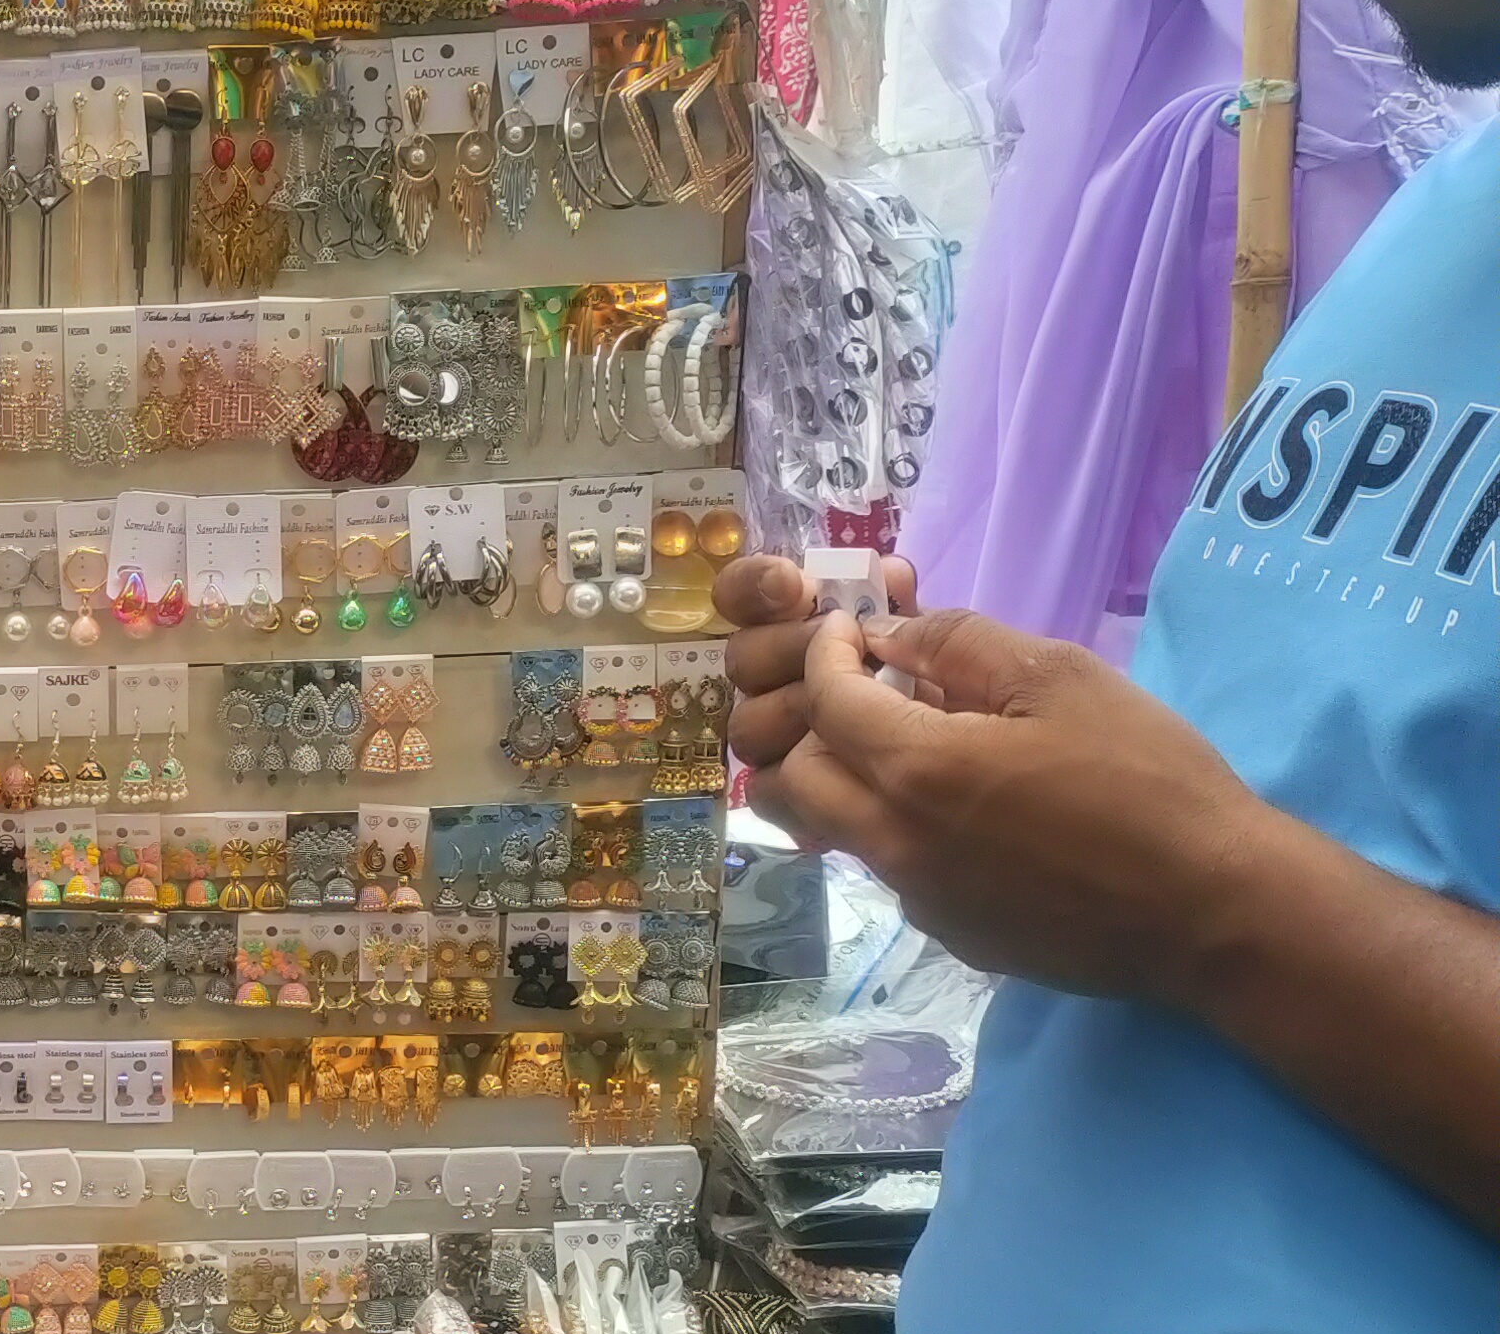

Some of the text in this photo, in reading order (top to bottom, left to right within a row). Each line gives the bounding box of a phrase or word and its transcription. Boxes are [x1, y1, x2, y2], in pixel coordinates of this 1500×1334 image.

[505, 38, 528, 55] LC
[401, 47, 425, 63] LC
[517, 55, 583, 72] LADY CARE
[414, 65, 481, 79] LADY CARE
[569, 482, 643, 499] Fashion Jewelry
[445, 502, 473, 516] S.W
[661, 495, 734, 509] Samruddhi Fashion
[346, 515, 386, 527] Samruddhi
[197, 523, 269, 536] Samruddhi Fashion
[16, 1051, 37, 1060] steel
[45, 1049, 104, 1059] Stainless steel
[110, 1049, 169, 1060] Stainless steel
